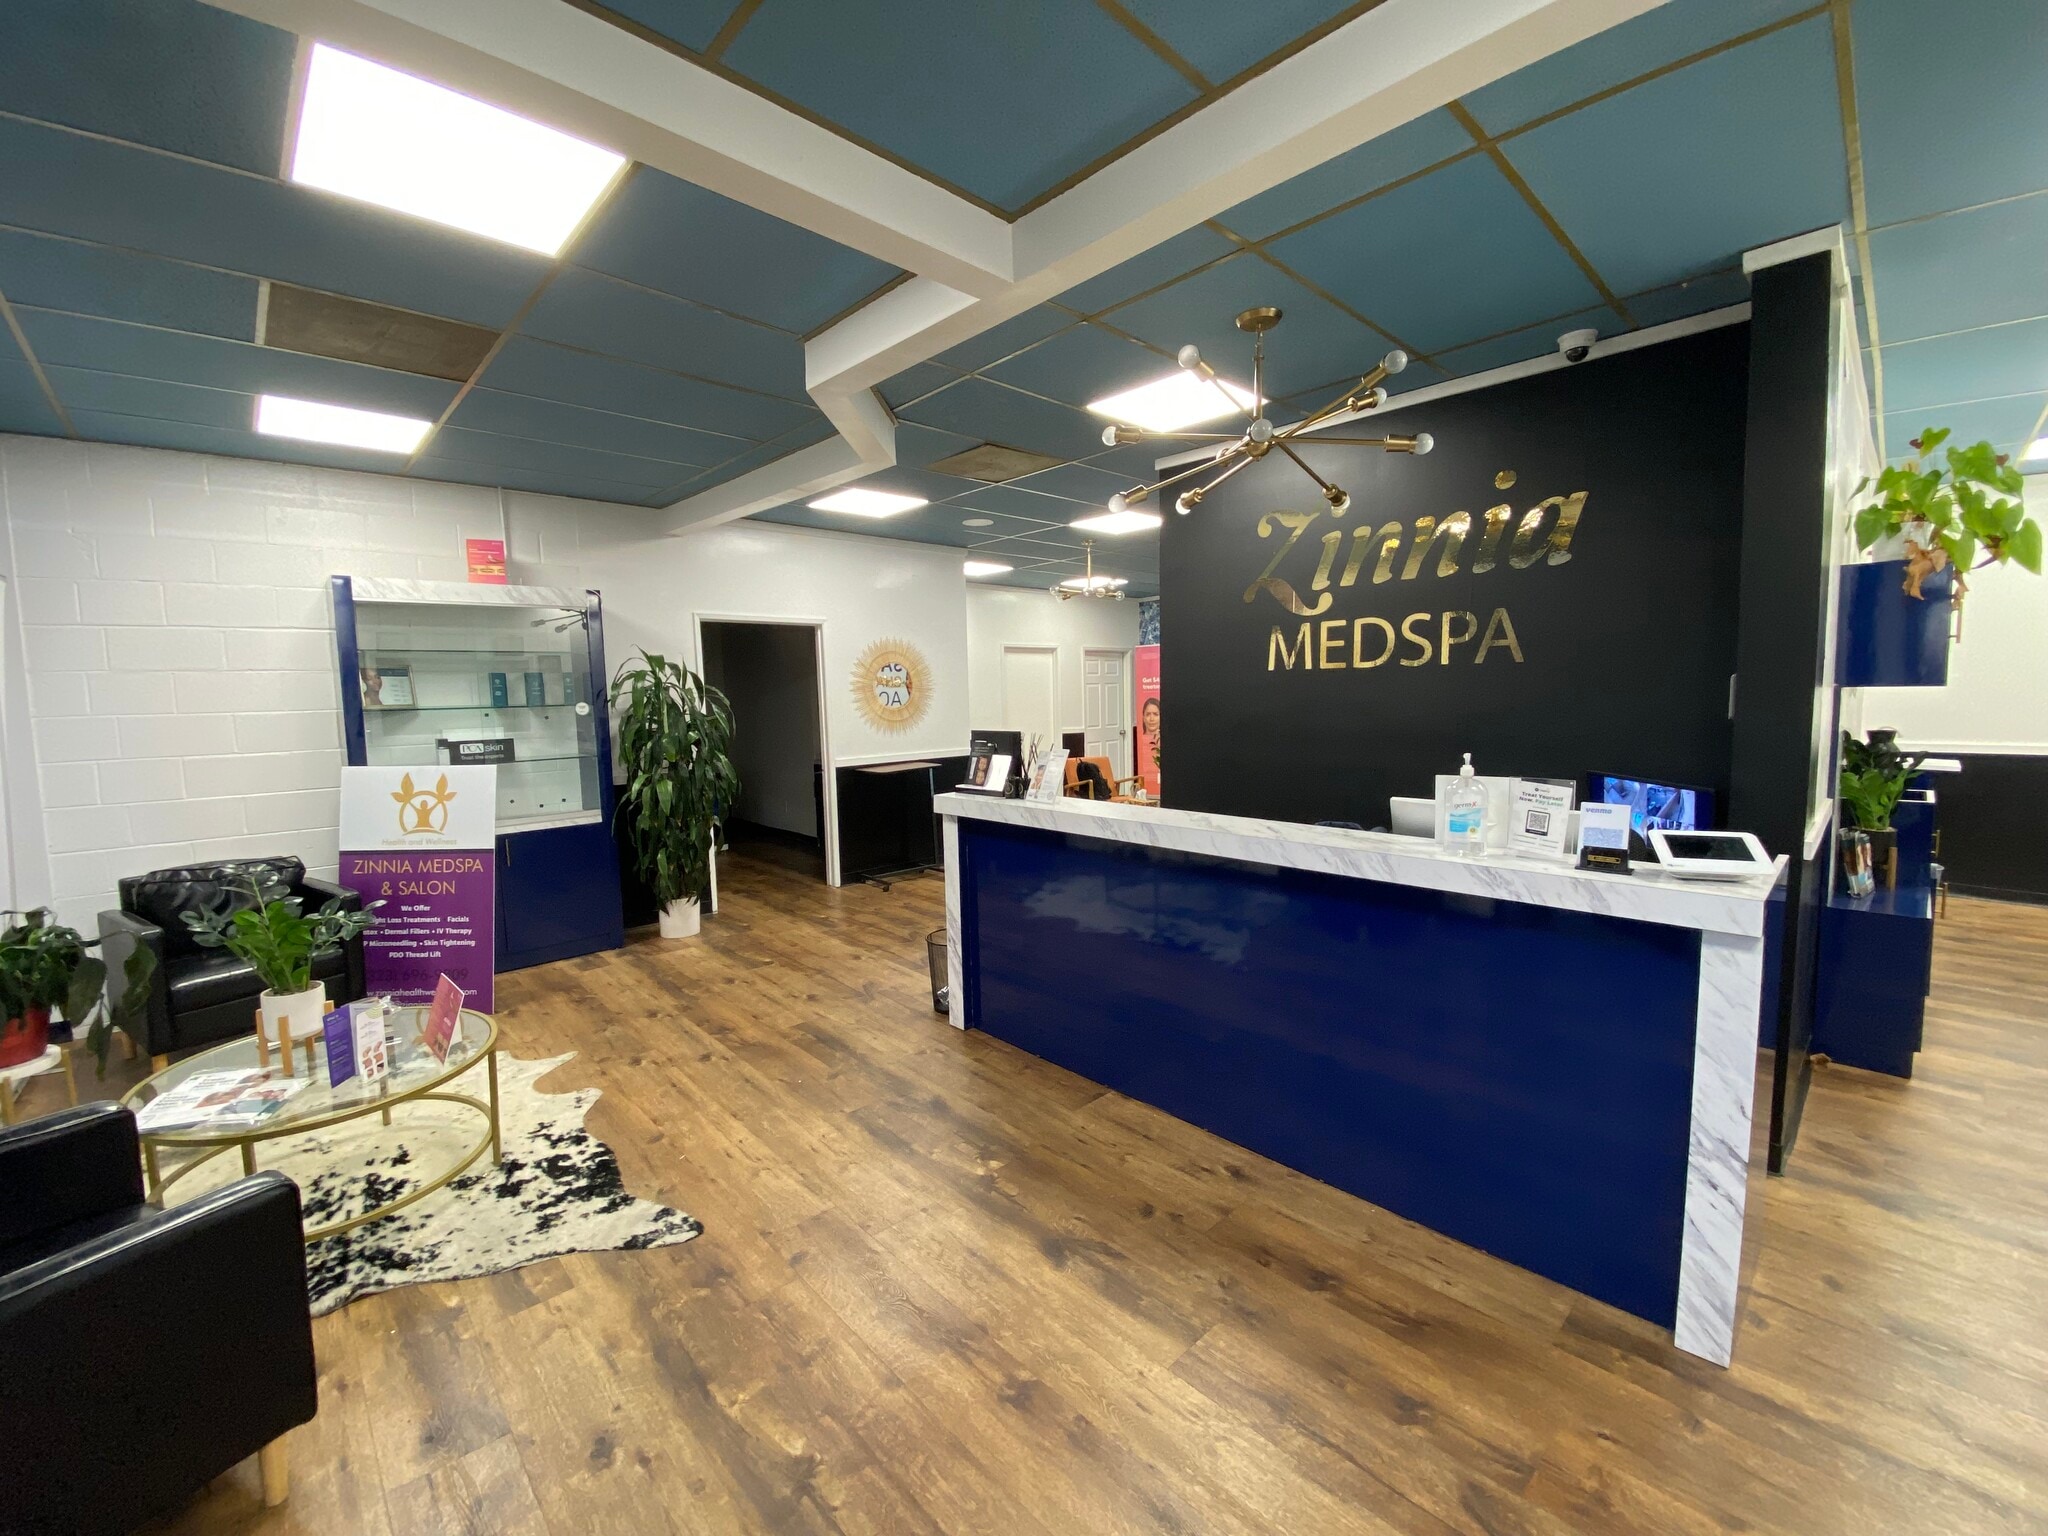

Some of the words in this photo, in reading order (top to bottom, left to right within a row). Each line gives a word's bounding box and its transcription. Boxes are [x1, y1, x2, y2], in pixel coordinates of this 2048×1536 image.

[1243, 469, 1589, 616] Zinnia
[1267, 607, 1525, 672] MEDSPA
[1585, 807, 1612, 815] venmo
[382, 838, 406, 846] Health
[353, 859, 413, 875] ZINNIA
[417, 858, 484, 873] MEDSPA
[381, 881, 393, 896] &
[398, 880, 456, 896] SALON
[445, 928, 472, 936] Therapy
[439, 939, 476, 947] Tightening
